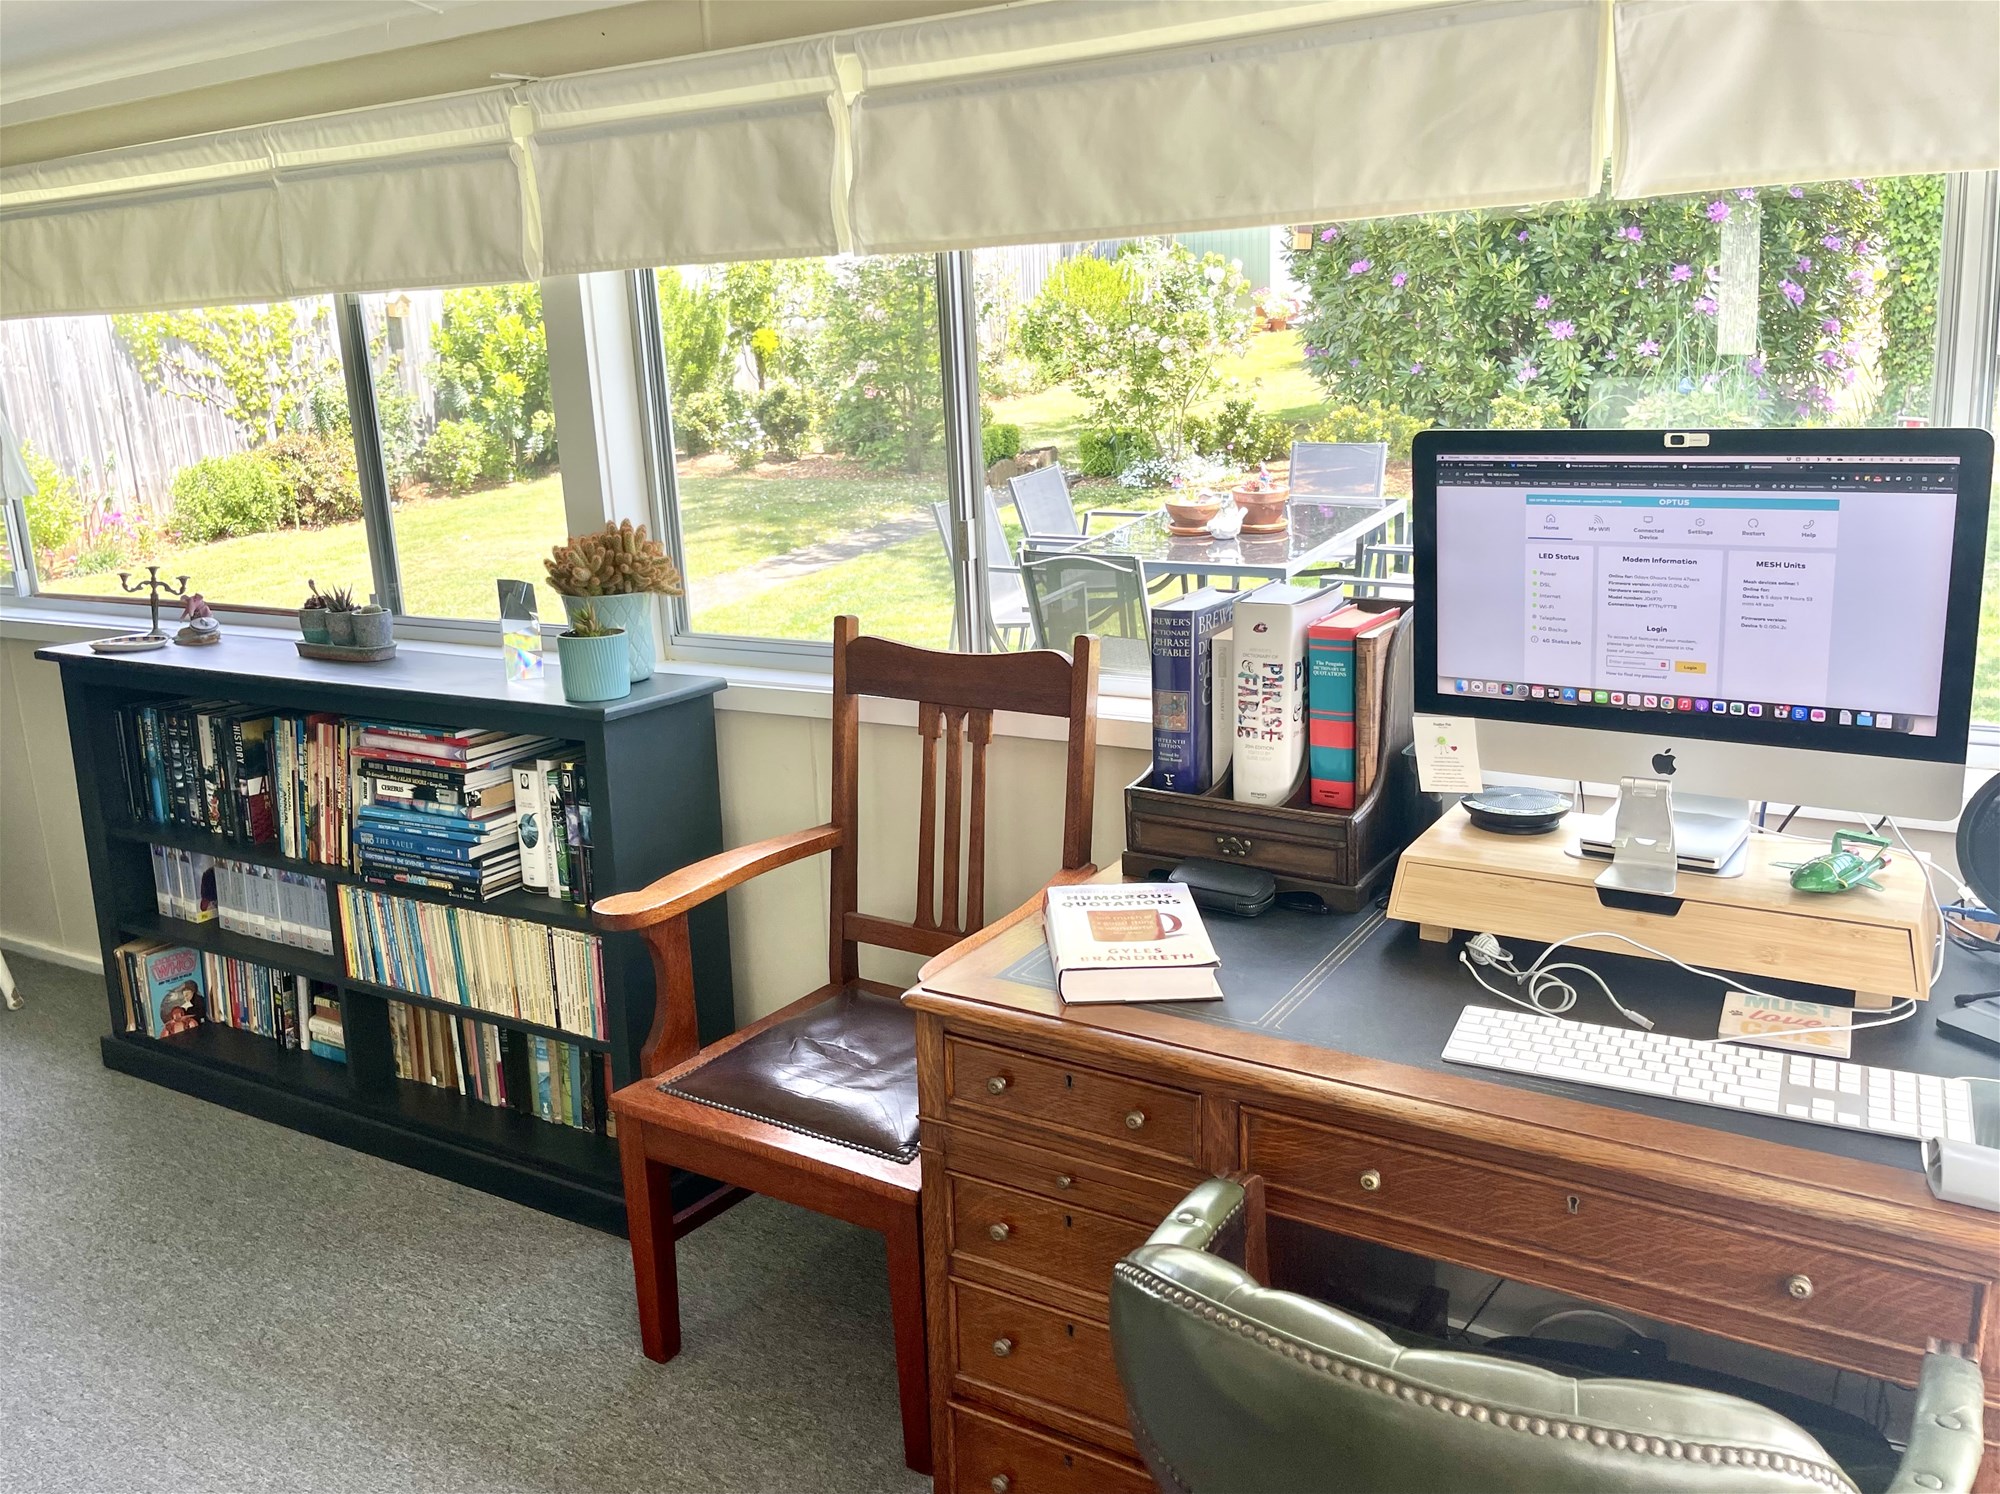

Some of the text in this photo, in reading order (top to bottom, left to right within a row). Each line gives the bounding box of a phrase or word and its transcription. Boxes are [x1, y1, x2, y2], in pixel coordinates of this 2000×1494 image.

[1659, 498, 1690, 506] OPTUS
[1652, 557, 1698, 565] Information
[1156, 638, 1190, 647] PHRASE
[1162, 648, 1190, 657] FABLE
[1237, 671, 1260, 738] FABLE
[1261, 662, 1284, 742] PHRASE
[392, 839, 414, 849] VAULT
[1062, 899, 1181, 908] QUOTATIONS
[1080, 953, 1194, 962] BRANDRETH
[152, 958, 196, 978] WHO
[1744, 995, 1836, 1018] MUST
[1749, 1010, 1822, 1028] love
